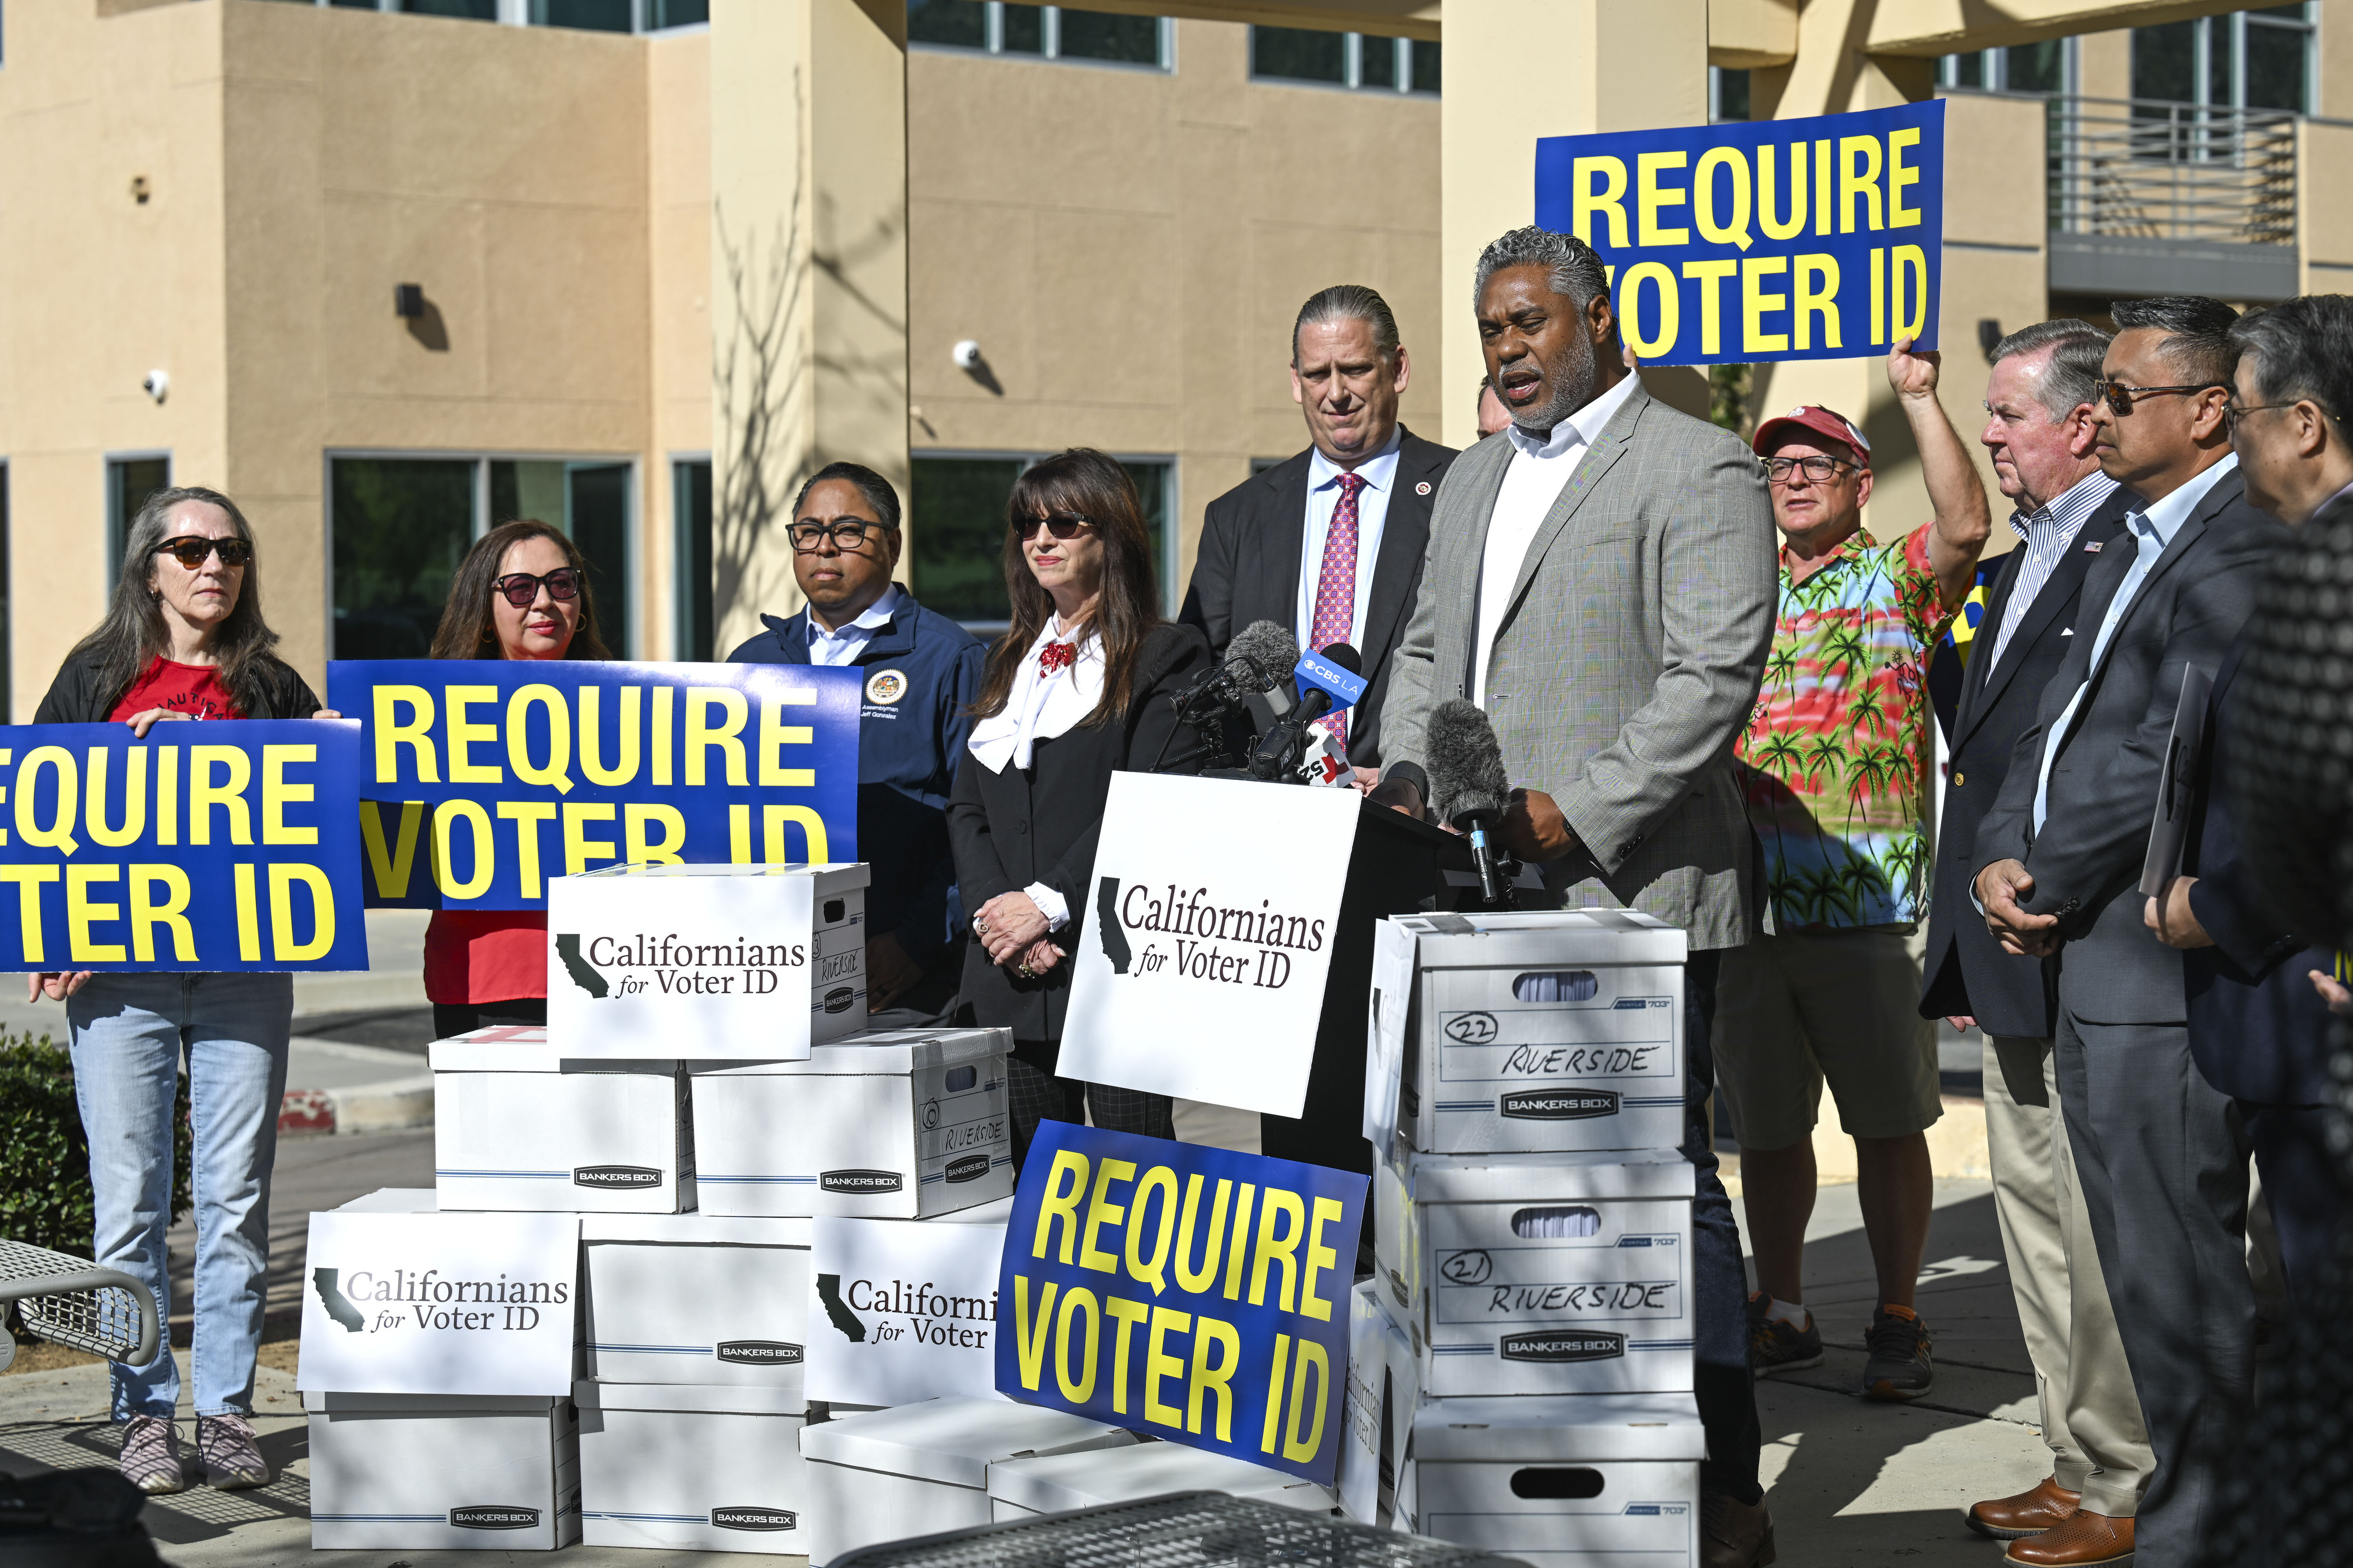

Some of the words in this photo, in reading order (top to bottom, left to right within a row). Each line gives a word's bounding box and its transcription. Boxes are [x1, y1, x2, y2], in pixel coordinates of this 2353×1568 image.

[1572, 127, 1921, 252] REQUIRE
[1605, 253, 1843, 358] OTER
[1870, 245, 1927, 345] ID
[1315, 666, 1341, 683] CBS
[1341, 679, 1357, 695] LA
[372, 683, 817, 795] REQUIRE
[0, 745, 318, 857] QUIRE
[729, 804, 828, 864] ID
[235, 863, 335, 962] ID
[1123, 885, 1325, 952] Californians
[590, 934, 804, 966] Californians
[1134, 943, 1167, 977] for
[1176, 940, 1249, 984] Voter
[1254, 950, 1290, 989] ID
[822, 949, 858, 982] RIVERSIDE
[618, 975, 649, 999] for
[655, 970, 734, 993] Voter
[744, 970, 778, 993] ID
[826, 996, 844, 1006] BANKERS
[1457, 1020, 1495, 1037] 22
[1508, 1099, 1578, 1110] BANKERS
[1581, 1099, 1612, 1108] BOX
[946, 1121, 1004, 1151] RIVERSIDE
[579, 1173, 631, 1182] BANKERS
[825, 1177, 874, 1186] BANKERS
[948, 1165, 975, 1177] BANKERS
[975, 1161, 987, 1170] BOX
[1032, 1149, 1343, 1322] REQUIRE
[1454, 1257, 1485, 1277] 21
[348, 1270, 568, 1304] Californians
[1489, 1282, 1677, 1312] RIVERSIDE
[371, 1310, 406, 1333] for
[412, 1305, 494, 1330] Voter
[503, 1306, 539, 1330] ID
[872, 1322, 904, 1345] for
[910, 1318, 987, 1349] Voter
[723, 1348, 773, 1356] BANKERS
[1508, 1342, 1581, 1352] BANKERS
[1584, 1340, 1617, 1350] BOX
[1014, 1275, 1240, 1443] VOTER
[1261, 1333, 1329, 1463] ID
[1353, 1402, 1368, 1446] Voter
[1368, 1422, 1377, 1455] ID
[456, 1513, 508, 1522] BANKERS
[717, 1513, 766, 1523] BANKERS
